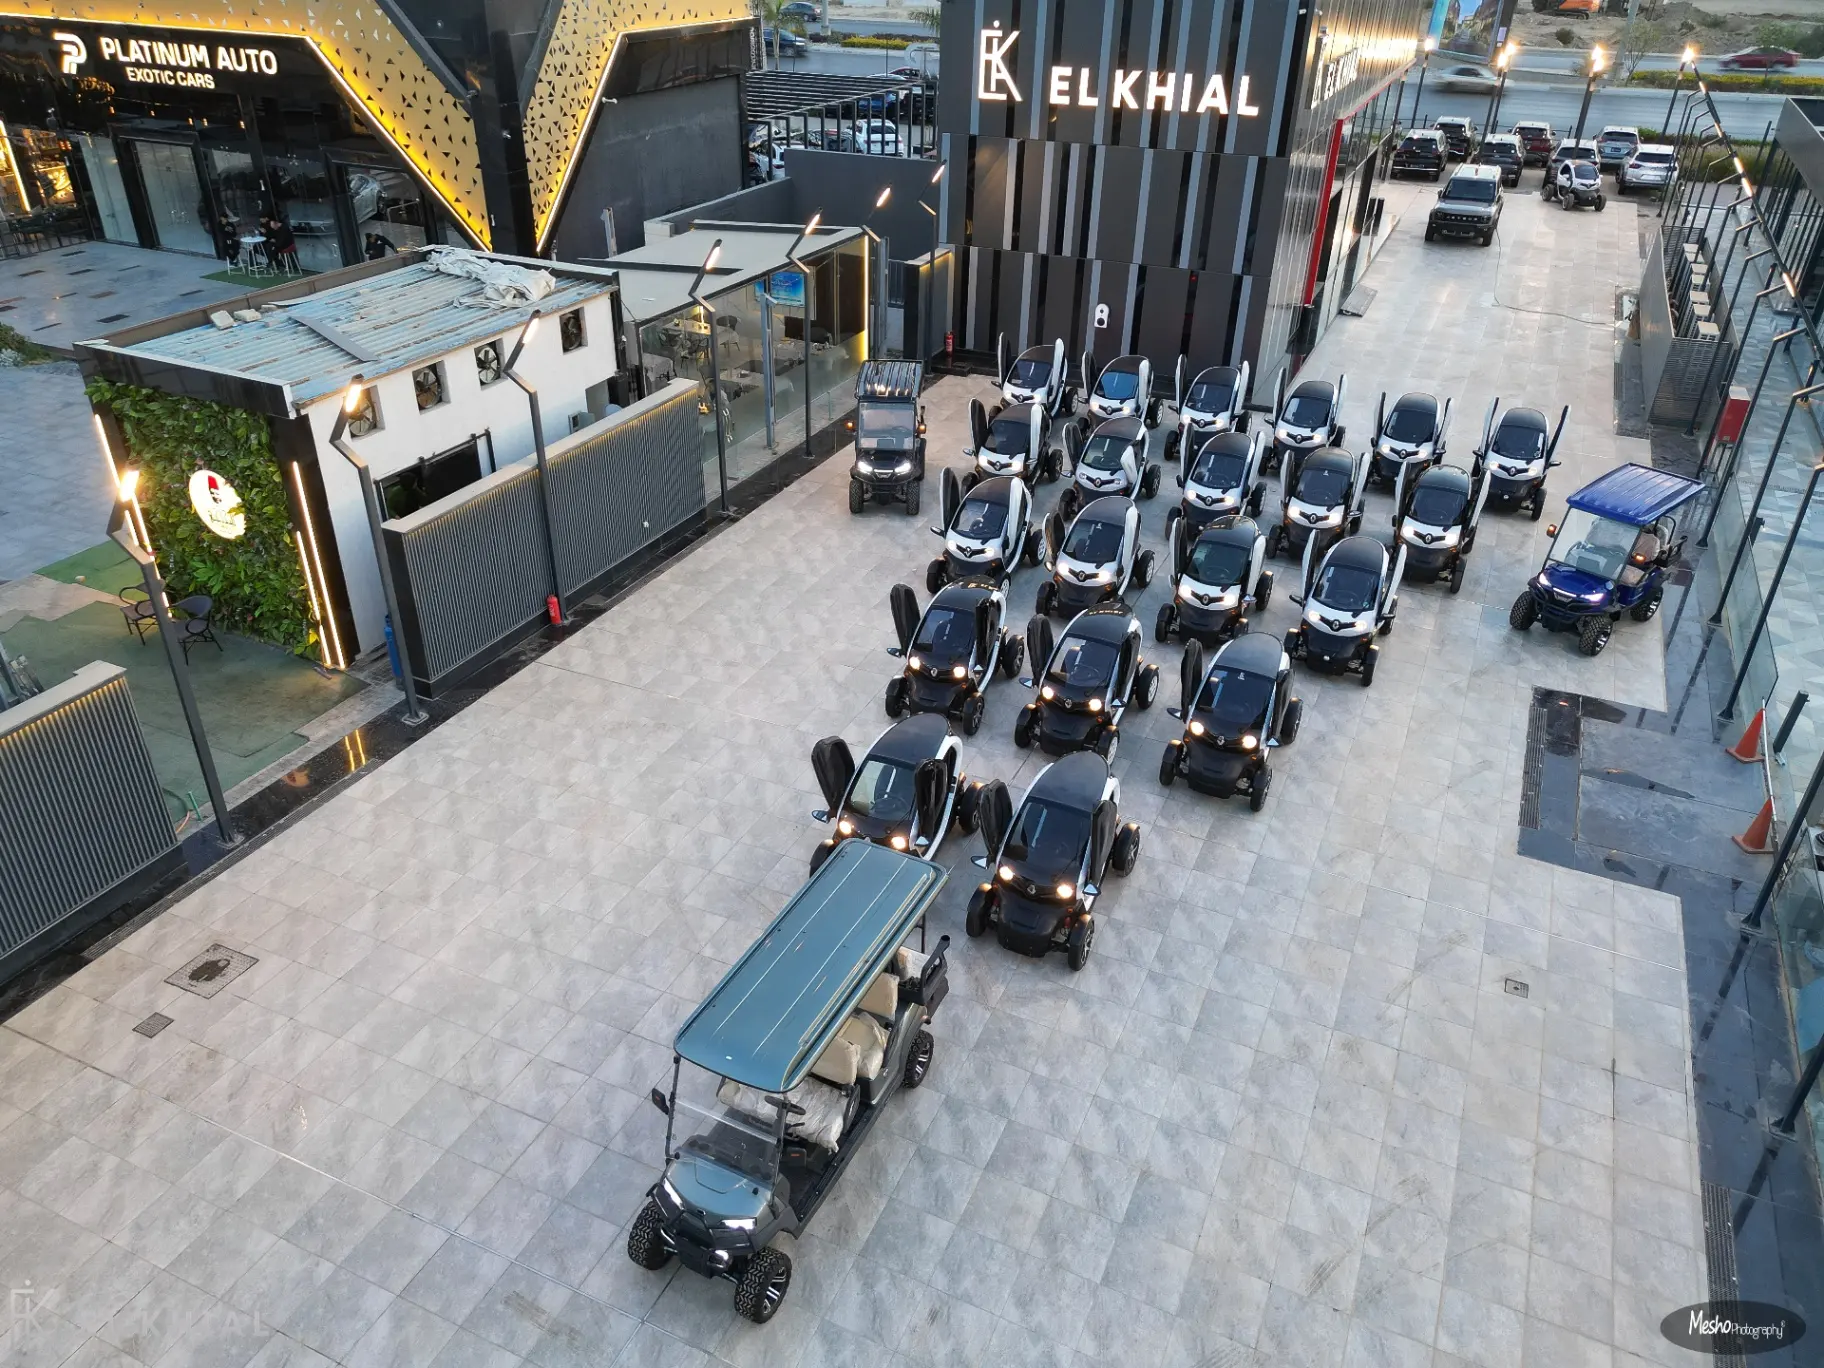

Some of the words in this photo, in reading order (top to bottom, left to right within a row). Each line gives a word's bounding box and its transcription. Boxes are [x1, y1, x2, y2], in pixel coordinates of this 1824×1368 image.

[100, 37, 211, 69] PLATINUM
[217, 46, 278, 75] AUTO
[126, 66, 175, 85] EXOTIC
[177, 70, 216, 90] CARS
[1049, 66, 1099, 107] EL
[1112, 69, 1259, 116] KHIAL
